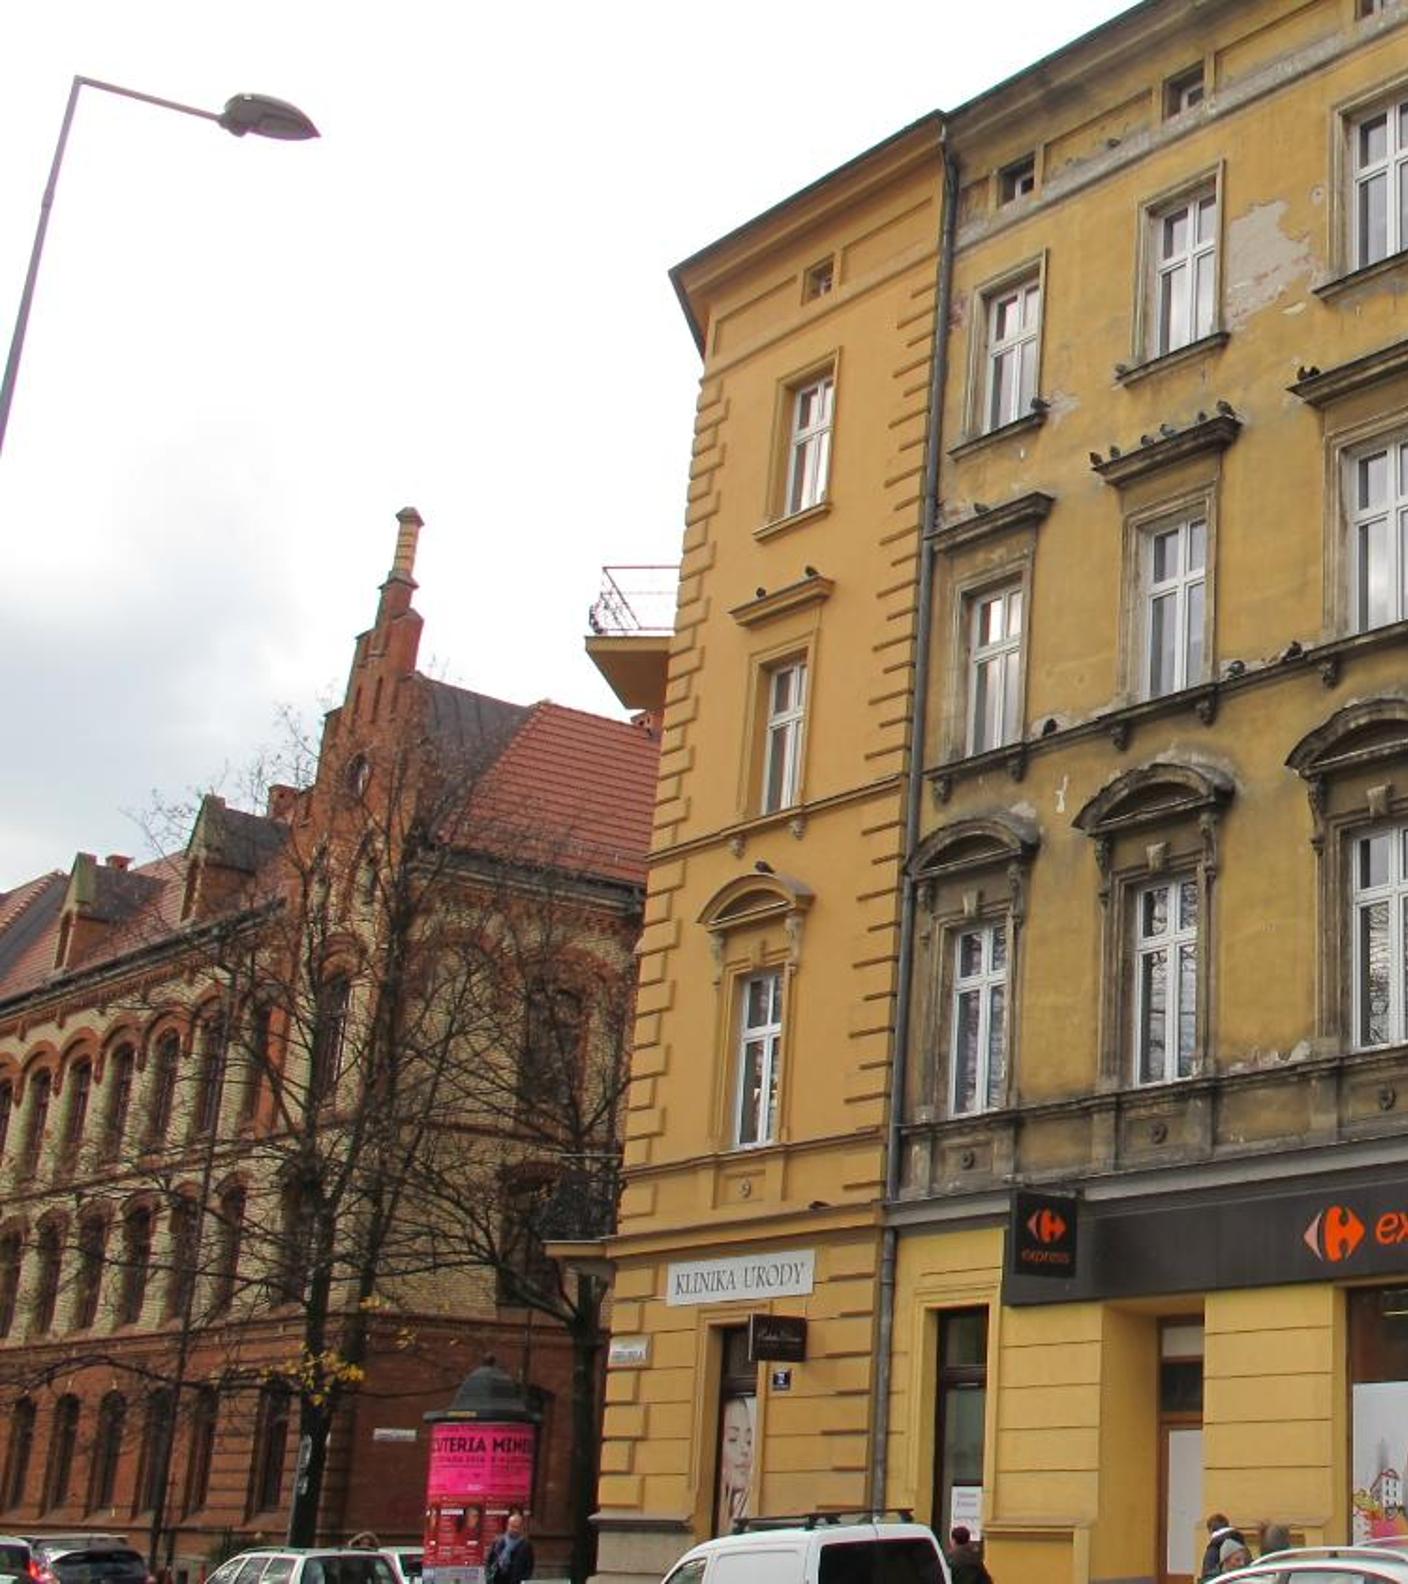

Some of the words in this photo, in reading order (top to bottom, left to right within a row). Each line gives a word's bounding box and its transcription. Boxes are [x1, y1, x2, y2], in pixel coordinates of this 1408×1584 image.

[1020, 1249, 1070, 1265] express
[674, 1269, 737, 1296] KLINIKA
[744, 1261, 805, 1289] URODY
